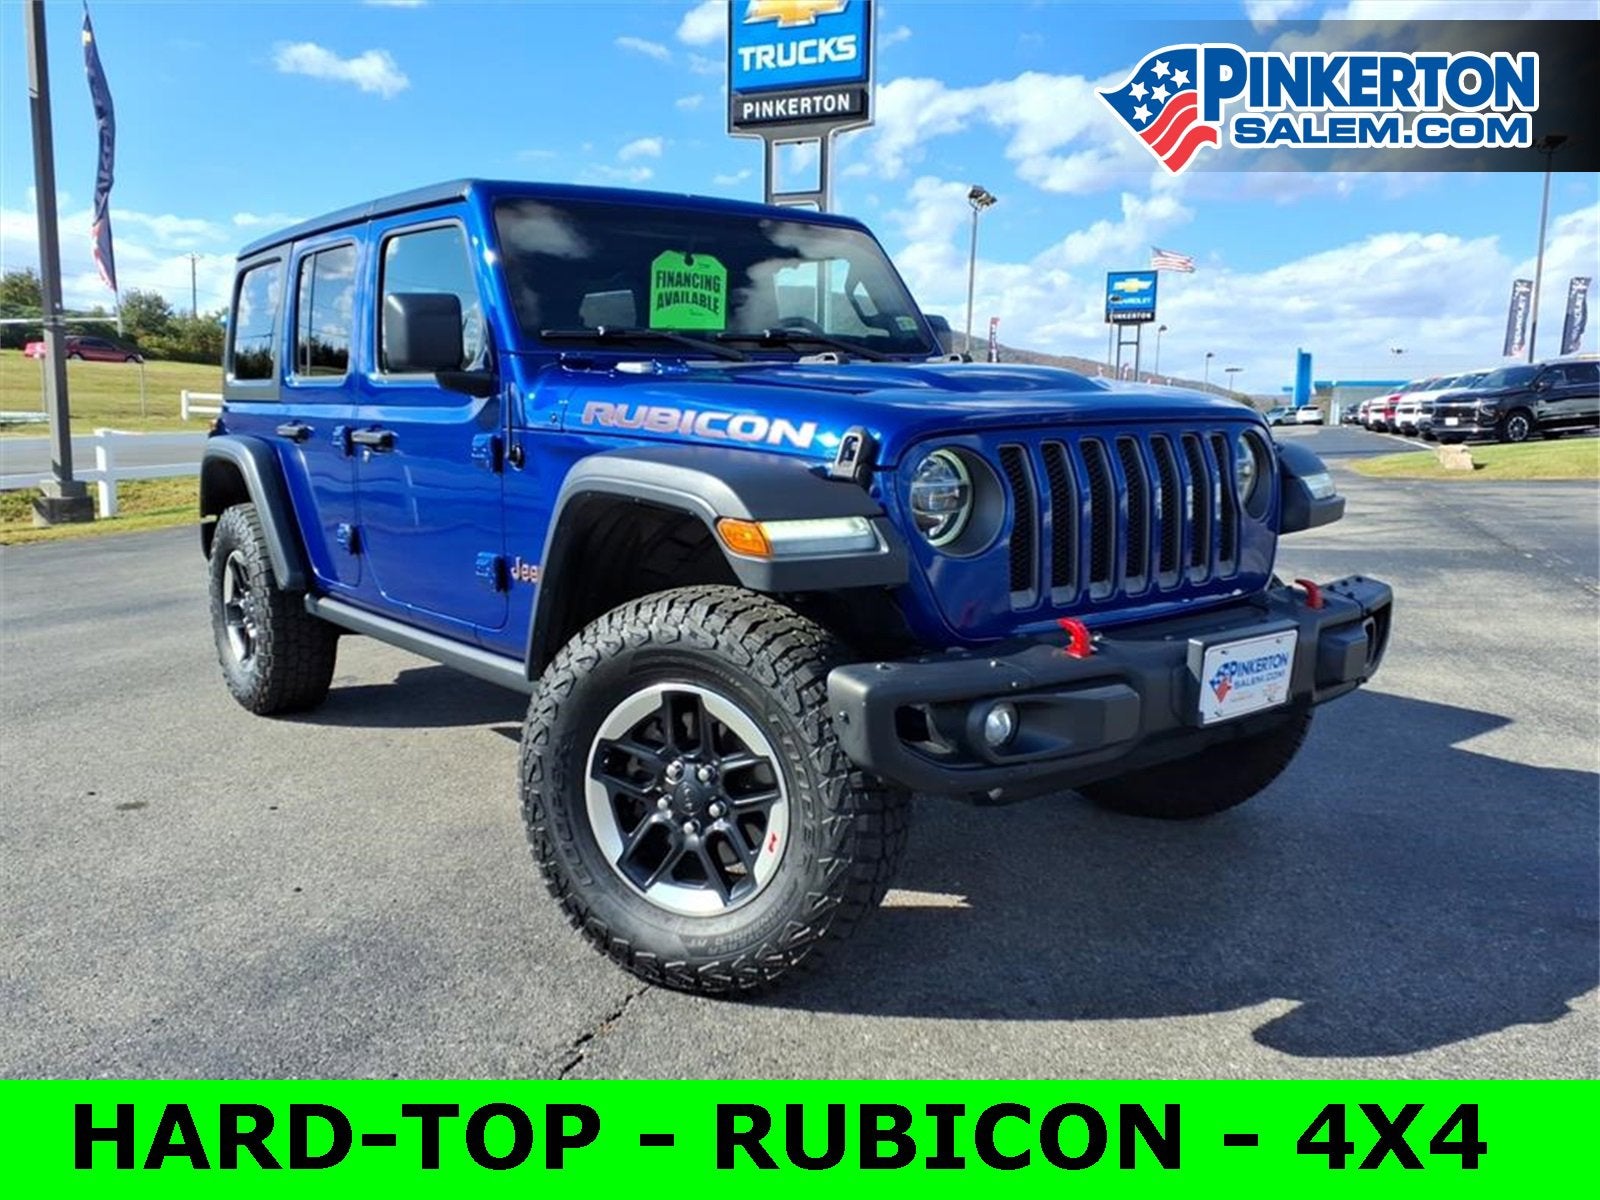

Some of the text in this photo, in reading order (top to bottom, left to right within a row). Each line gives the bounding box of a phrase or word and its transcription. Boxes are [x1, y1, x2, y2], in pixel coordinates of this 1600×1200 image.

[738, 34, 857, 72] TRUCKS
[743, 93, 850, 120] PINKERTON
[656, 270, 720, 293] FINANCING
[656, 291, 720, 316] AVAILABLE
[581, 400, 818, 449] RUBICON
[510, 556, 541, 583] Jee
[1231, 652, 1288, 677] PINKERTON
